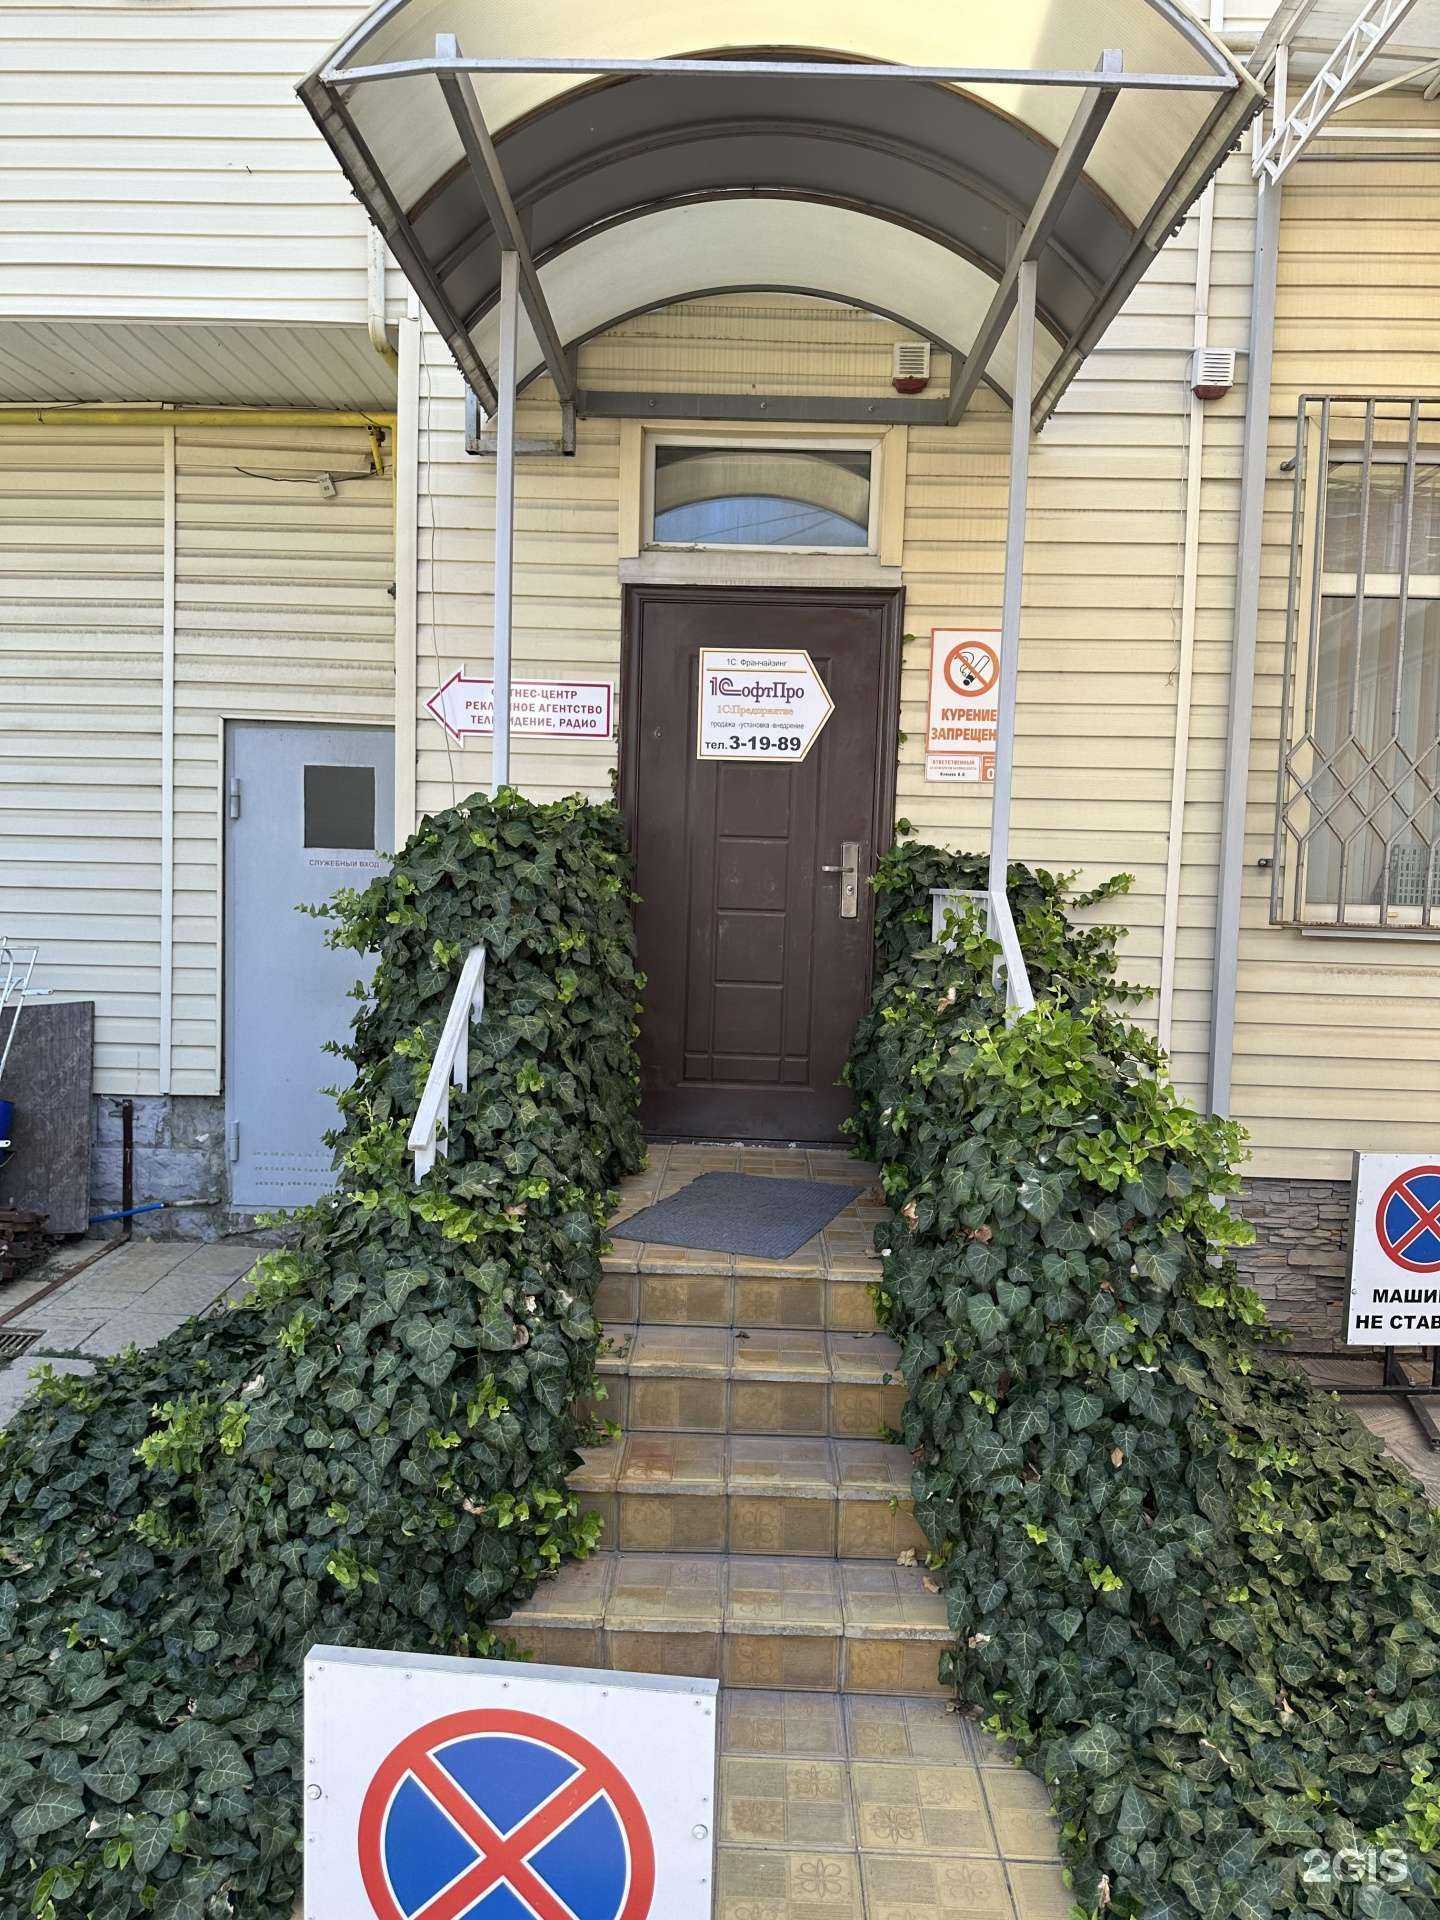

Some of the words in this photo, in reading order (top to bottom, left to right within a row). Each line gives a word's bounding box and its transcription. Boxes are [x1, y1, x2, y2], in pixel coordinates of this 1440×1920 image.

[465, 701, 536, 713] РЕКЛНОЕ
[538, 703, 603, 715] АГЕНТСТВО
[941, 707, 997, 722] КУРЕНИЕ
[559, 718, 598, 729] РАДИО
[705, 740, 728, 751] тел.
[729, 734, 801, 751] 3-19-89
[931, 727, 997, 743] ЗАПРЕЩЕН
[308, 859, 358, 868] СЛУЖЕБНЫЙ
[359, 860, 380, 869] ВХОД
[1373, 1288, 1440, 1303] МАШИ
[1355, 1314, 1383, 1329] НЕ
